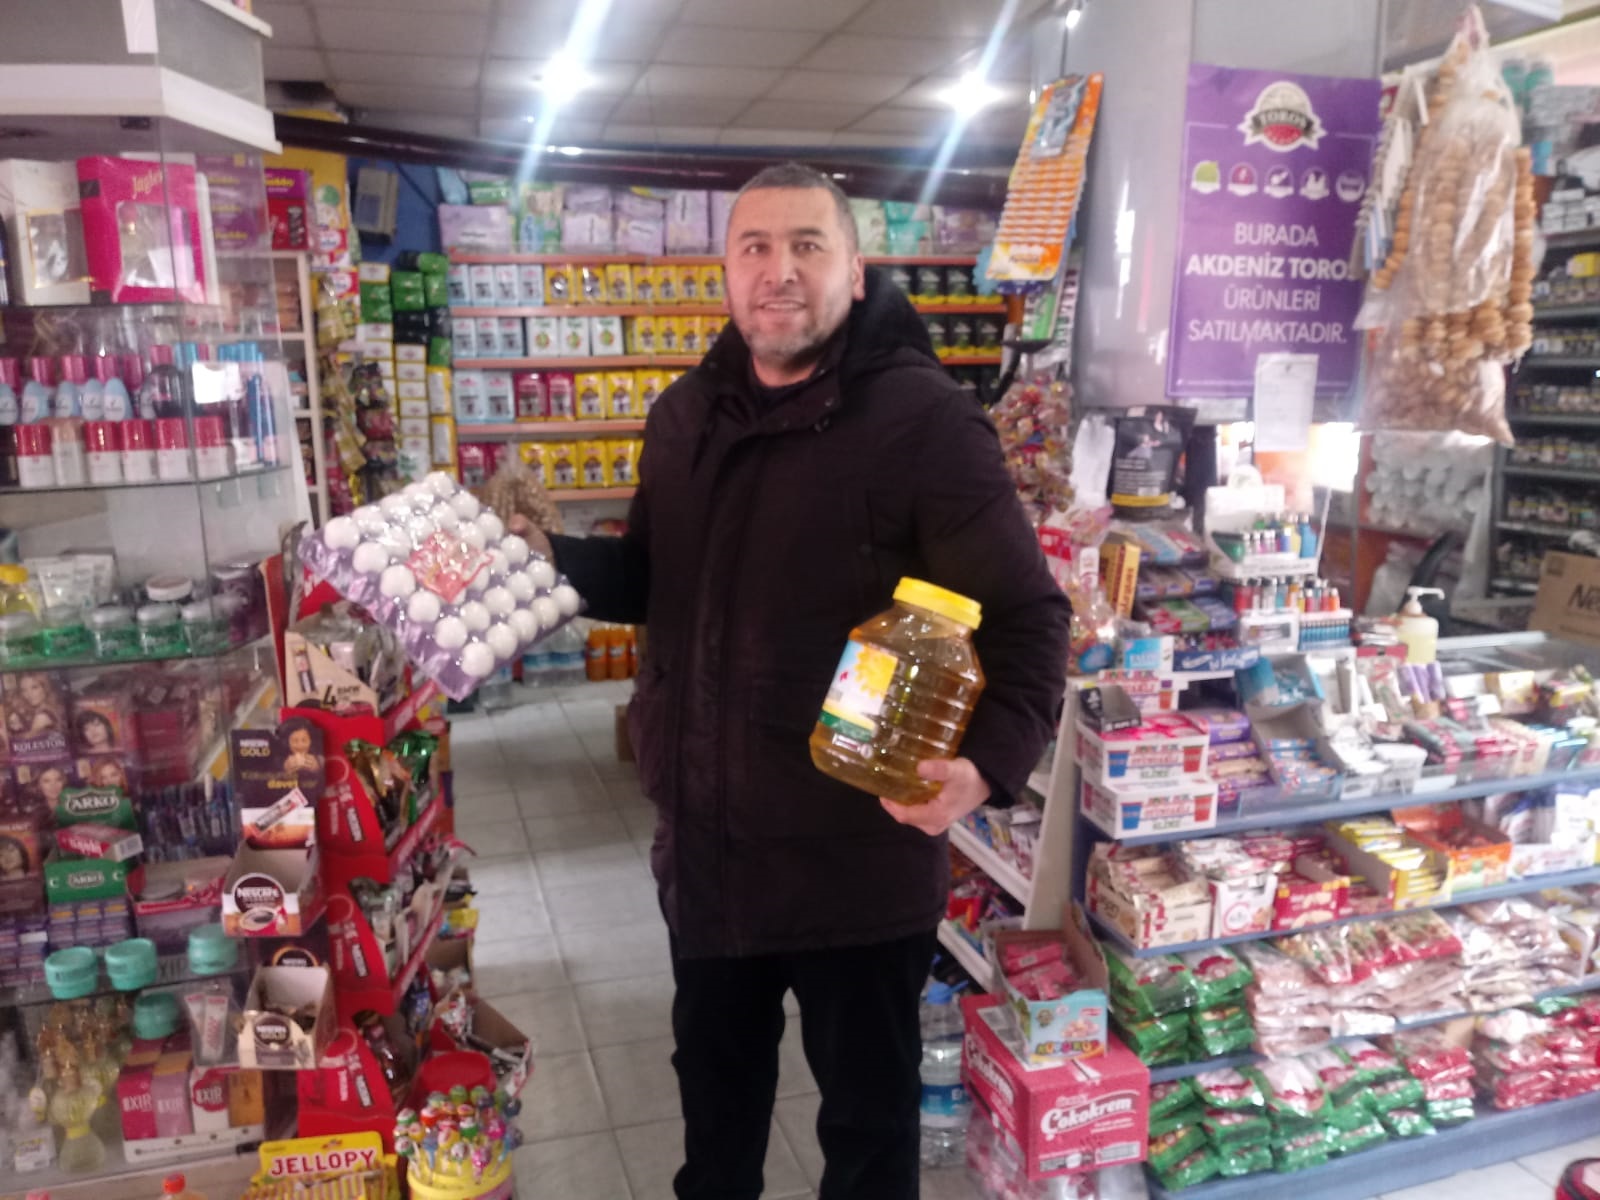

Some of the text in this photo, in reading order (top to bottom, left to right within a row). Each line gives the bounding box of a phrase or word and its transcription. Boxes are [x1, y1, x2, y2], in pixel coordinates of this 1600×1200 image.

[1233, 221, 1319, 247] BURADA
[1185, 251, 1285, 279] AKDENİZ
[1223, 283, 1322, 312] ÜRÜNLERİ
[1187, 319, 1347, 344] SATILMAKTADIR.
[240, 747, 271, 757] GOLD
[71, 795, 117, 811] ARKO
[1040, 1097, 1133, 1141] Çokokrem
[270, 1149, 376, 1176] JELLOPY
